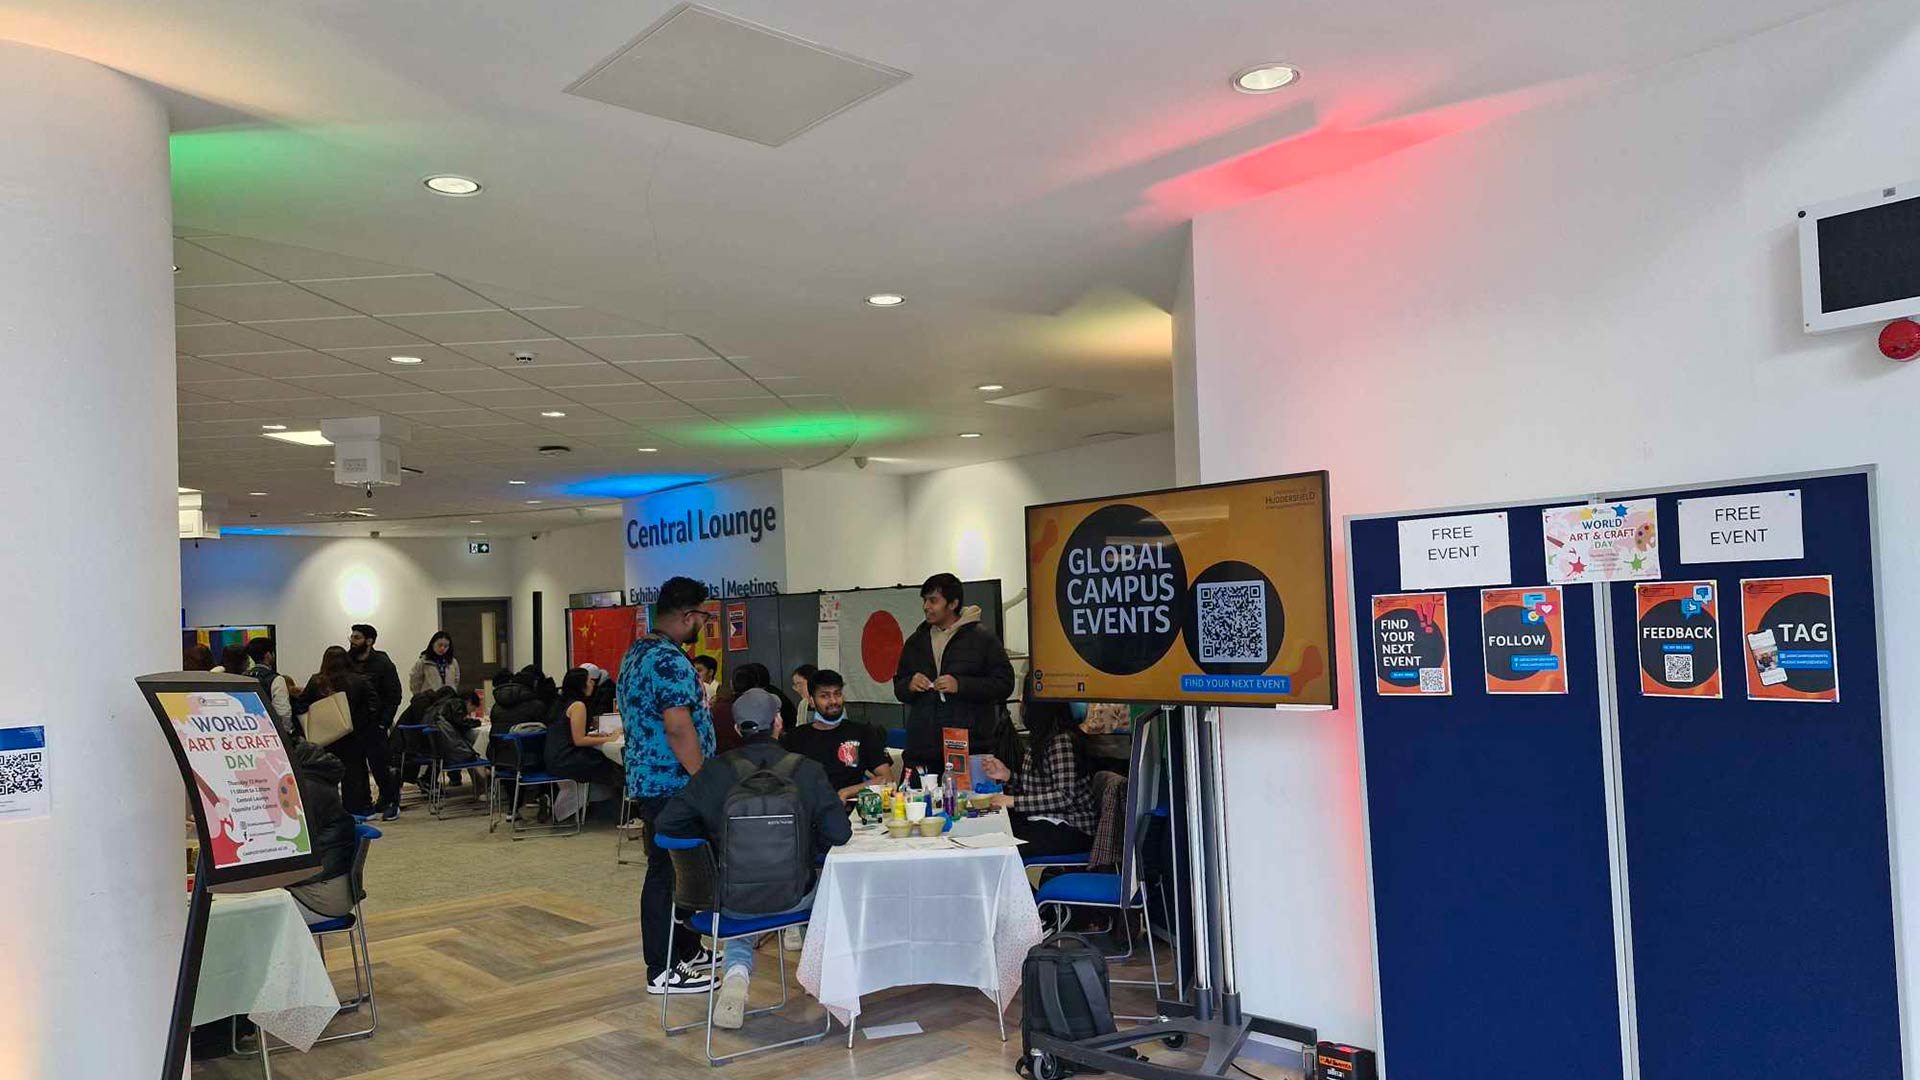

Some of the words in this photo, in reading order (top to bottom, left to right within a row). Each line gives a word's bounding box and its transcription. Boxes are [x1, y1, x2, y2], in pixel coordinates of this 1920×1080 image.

[1714, 505, 1761, 522] FREE
[627, 509, 693, 549] Central
[698, 506, 776, 543] Lounge
[1582, 518, 1623, 530] WORLD
[1431, 526, 1473, 541] FREE
[1569, 532, 1589, 542] ART
[1593, 531, 1601, 540] &
[1604, 529, 1634, 539] CRAFT
[1710, 528, 1768, 545] EVENT
[1594, 540, 1613, 549] DAY
[1068, 542, 1172, 575] GLOBAL
[1428, 545, 1480, 561] EVENT
[727, 577, 778, 597] Meetings
[1066, 573, 1175, 606] CAMPUS
[1073, 605, 1171, 636] EVENTS
[1381, 619, 1409, 630] FIND
[1381, 631, 1415, 642] YOUR
[1488, 634, 1546, 647] FOLLOW
[1643, 627, 1713, 639] FEEDBACK
[1778, 623, 1828, 643] TAG
[1382, 643, 1414, 654] NEXT
[1383, 656, 1422, 667] EVENT
[1184, 678, 1204, 687] FIND
[1206, 679, 1230, 688] YOUR
[1231, 679, 1254, 688] NEXT
[1256, 679, 1286, 689] EVENT
[191, 716, 258, 733] WORLD
[187, 736, 215, 753] ART
[221, 736, 233, 751] &
[235, 734, 280, 751] CRAFT
[224, 755, 256, 770] DAY
